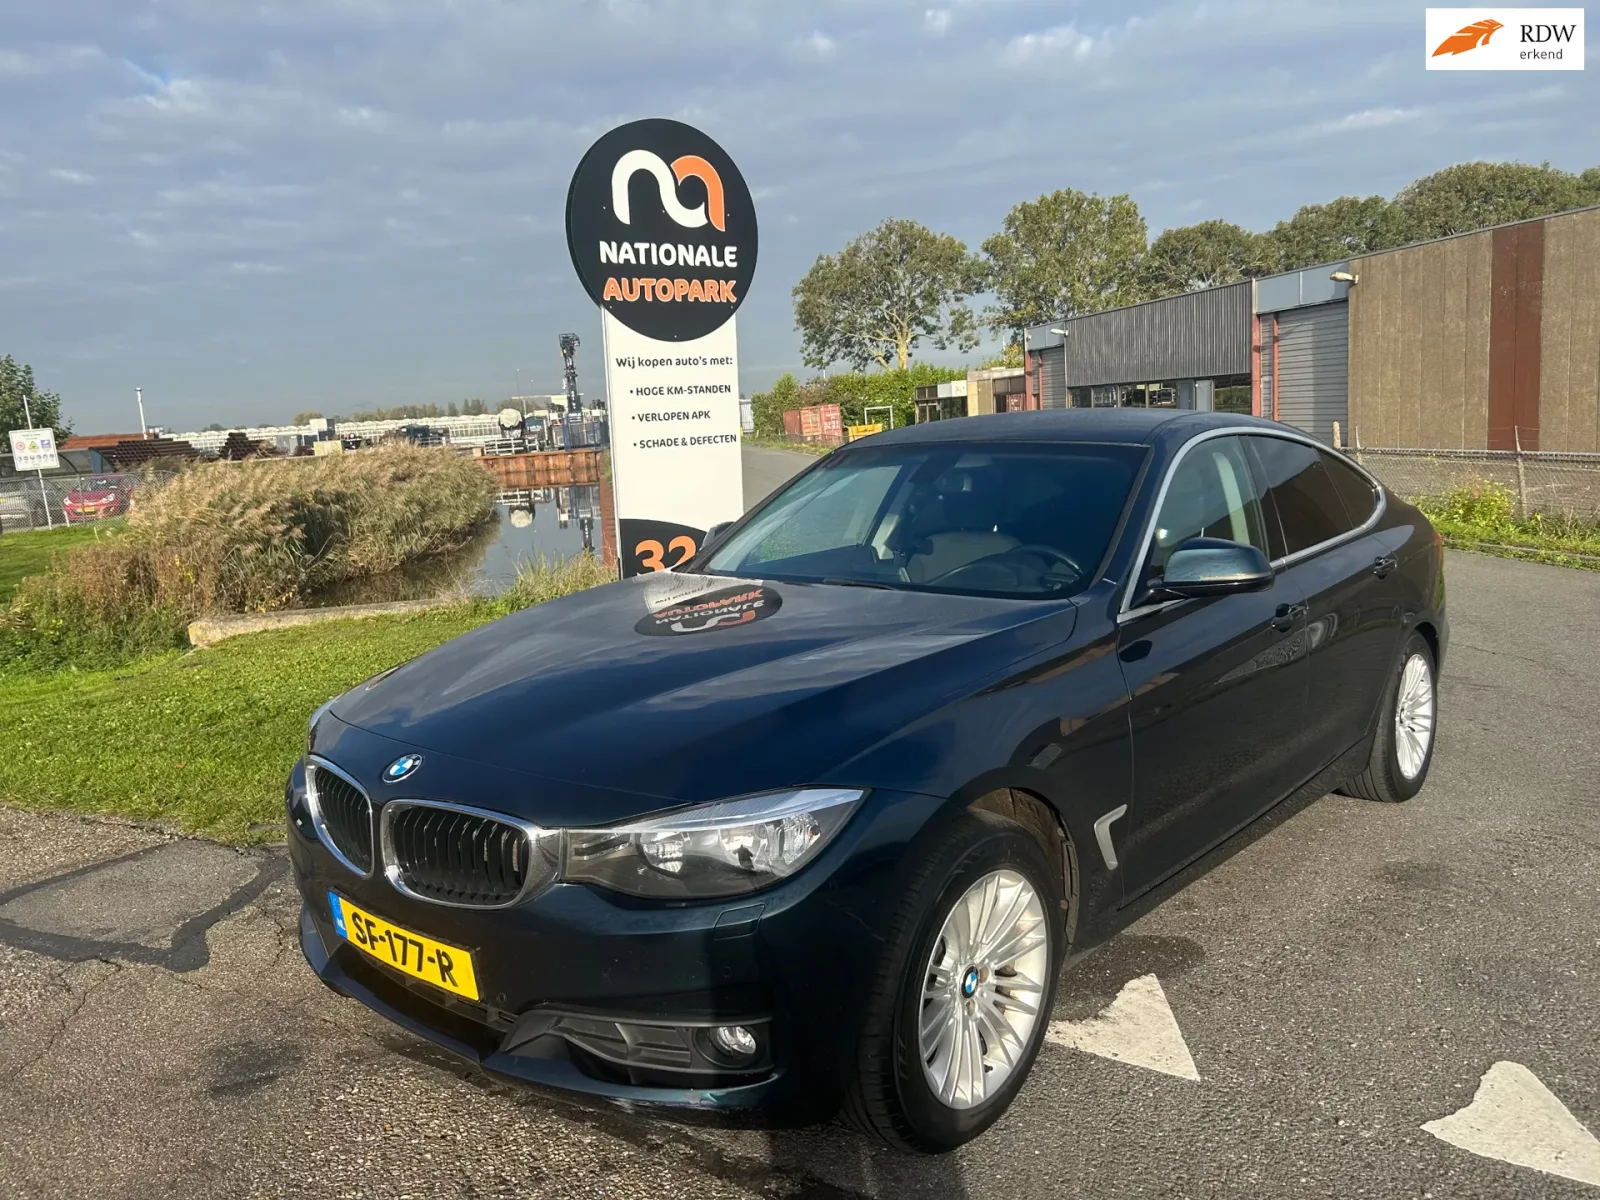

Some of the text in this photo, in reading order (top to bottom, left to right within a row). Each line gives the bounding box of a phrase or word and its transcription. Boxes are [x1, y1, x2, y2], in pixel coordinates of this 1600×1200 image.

[599, 240, 738, 268] NATIONALE
[603, 277, 738, 303] AUTOPARK
[615, 356, 733, 369] Wij kopen auto's met:
[635, 384, 731, 396] HOGE KM-STANDEN
[637, 410, 711, 423] VERLOPEN APK
[639, 434, 737, 449] SCHADE & DEFECTEN
[635, 535, 697, 575] 32
[351, 911, 460, 988] SF-177-R
